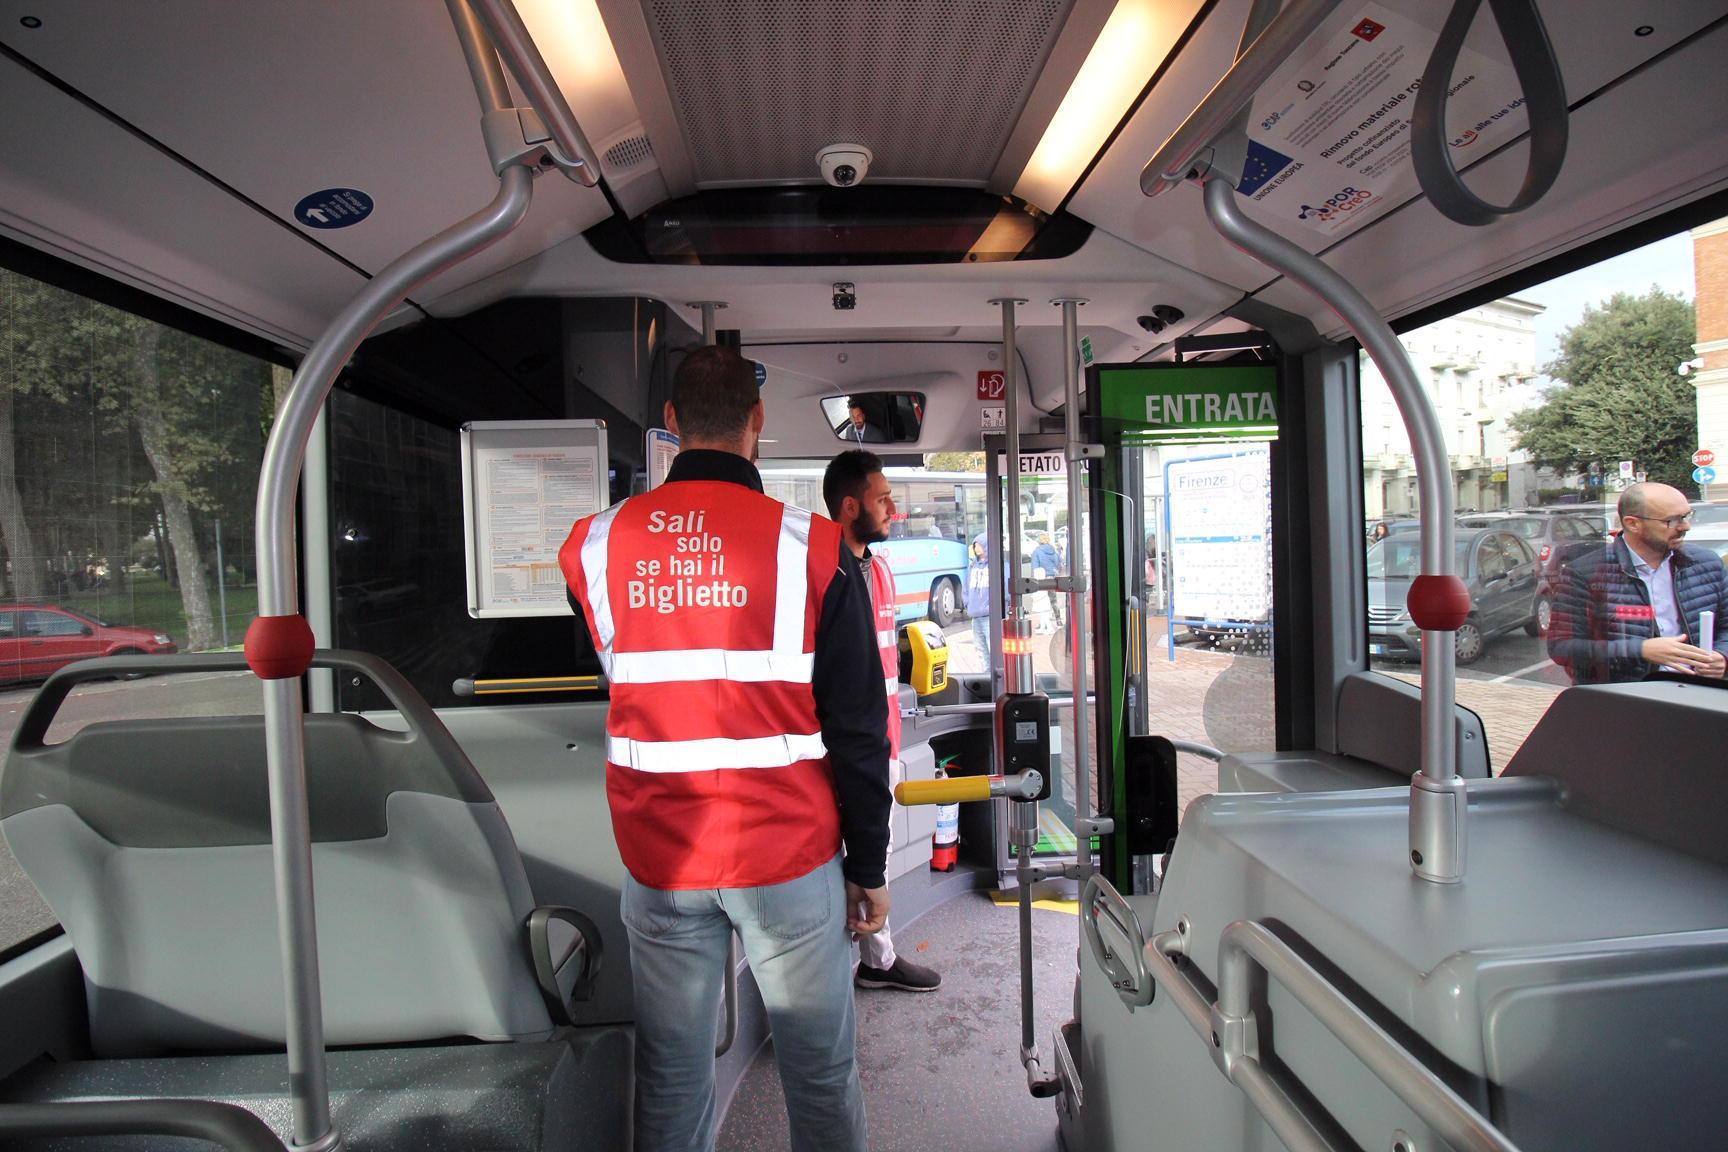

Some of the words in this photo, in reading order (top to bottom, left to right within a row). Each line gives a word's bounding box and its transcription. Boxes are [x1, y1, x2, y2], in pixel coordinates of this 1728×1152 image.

[1320, 130, 1360, 159] Rinnovo
[1358, 92, 1407, 132] materiale
[1448, 136, 1463, 147] Le
[1462, 129, 1476, 141] ali
[1475, 119, 1493, 132] alle
[1491, 108, 1509, 121] tue
[1337, 144, 1364, 166] Progetto
[1355, 148, 1374, 164] fondo
[1373, 129, 1400, 151] Europeo
[1253, 182, 1278, 202] UNIONE
[1276, 161, 1304, 188] EUROPEA
[1328, 186, 1360, 207] POR
[1339, 190, 1372, 211] CreO
[1145, 391, 1279, 424] ENTRATA
[1693, 454, 1714, 463] STOP
[1179, 474, 1228, 489] Firenze
[647, 510, 706, 533] Sali
[676, 532, 722, 553] solo
[635, 559, 661, 577] se
[669, 554, 702, 576] hai
[711, 554, 725, 576] il
[628, 578, 748, 614] Biglietto
